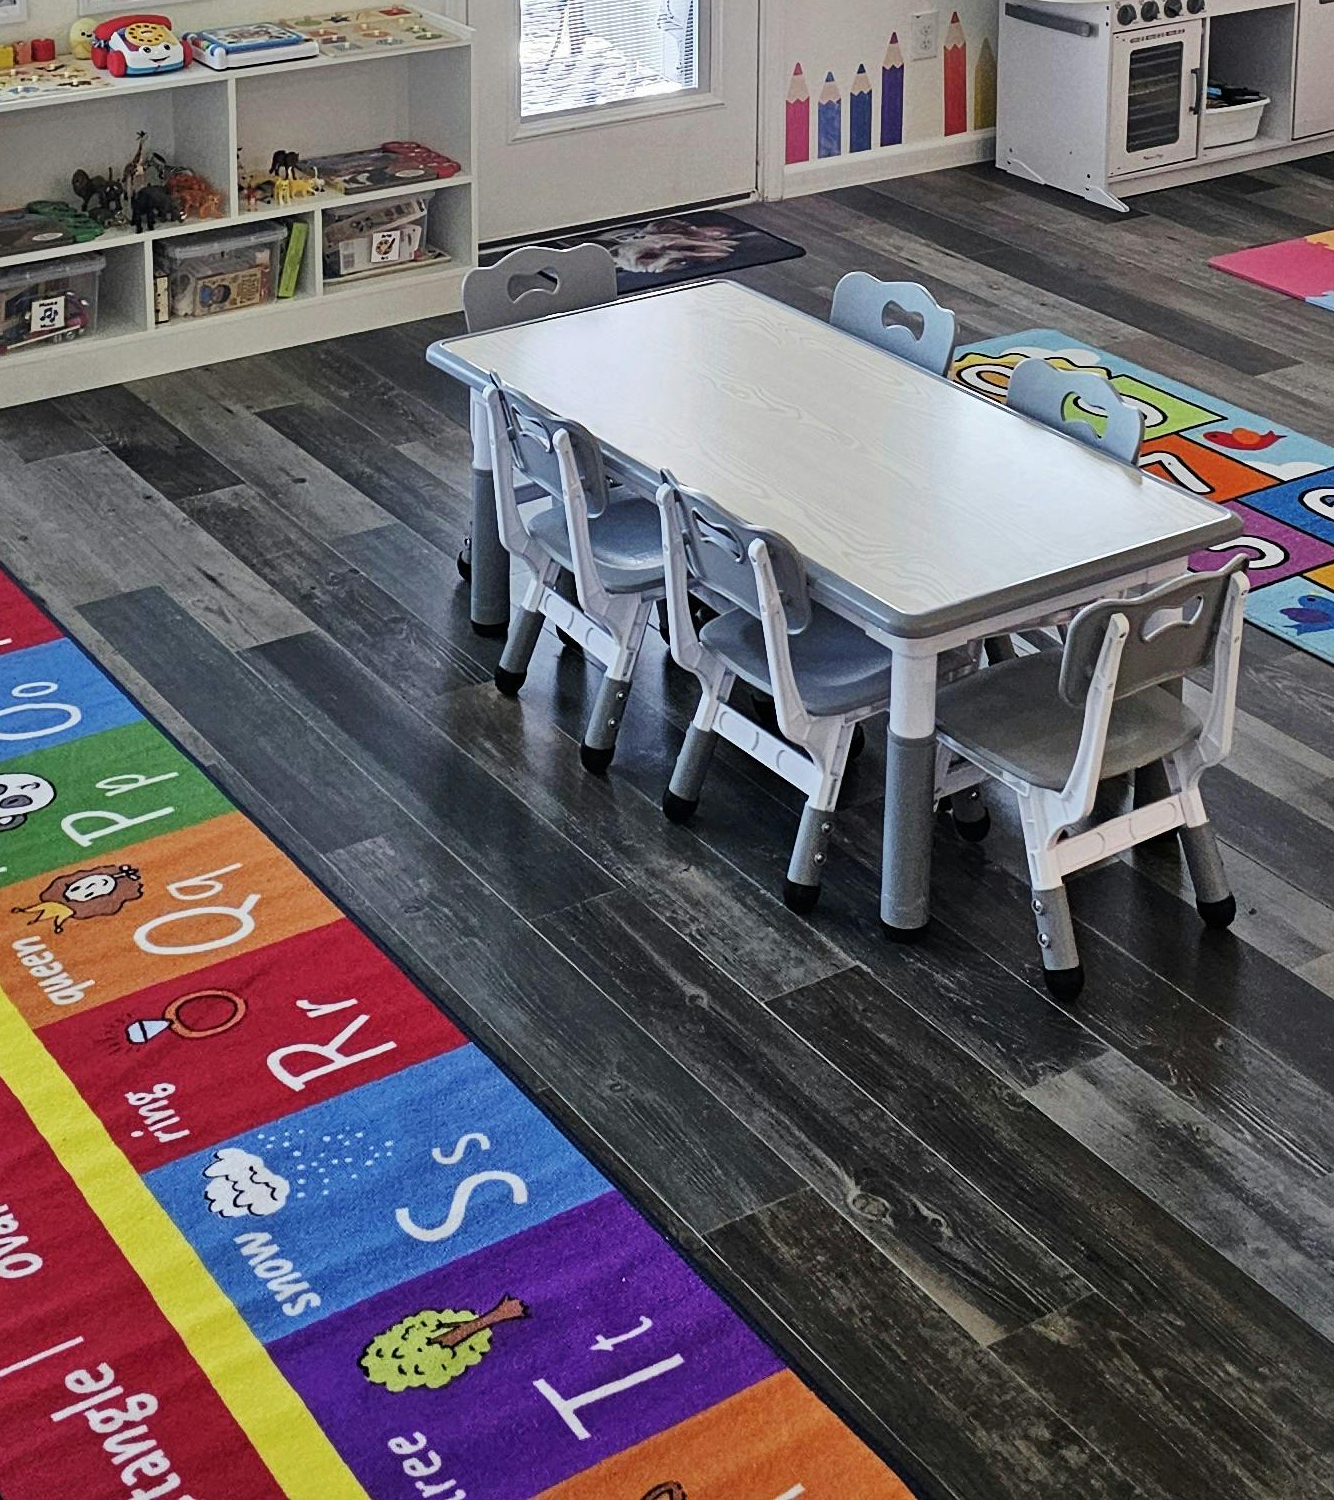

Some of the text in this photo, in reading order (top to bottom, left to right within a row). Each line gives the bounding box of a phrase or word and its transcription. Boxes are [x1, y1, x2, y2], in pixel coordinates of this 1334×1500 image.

[12, 936, 95, 1005] queen
[125, 1083, 189, 1142] ring
[234, 1232, 321, 1316] snow
